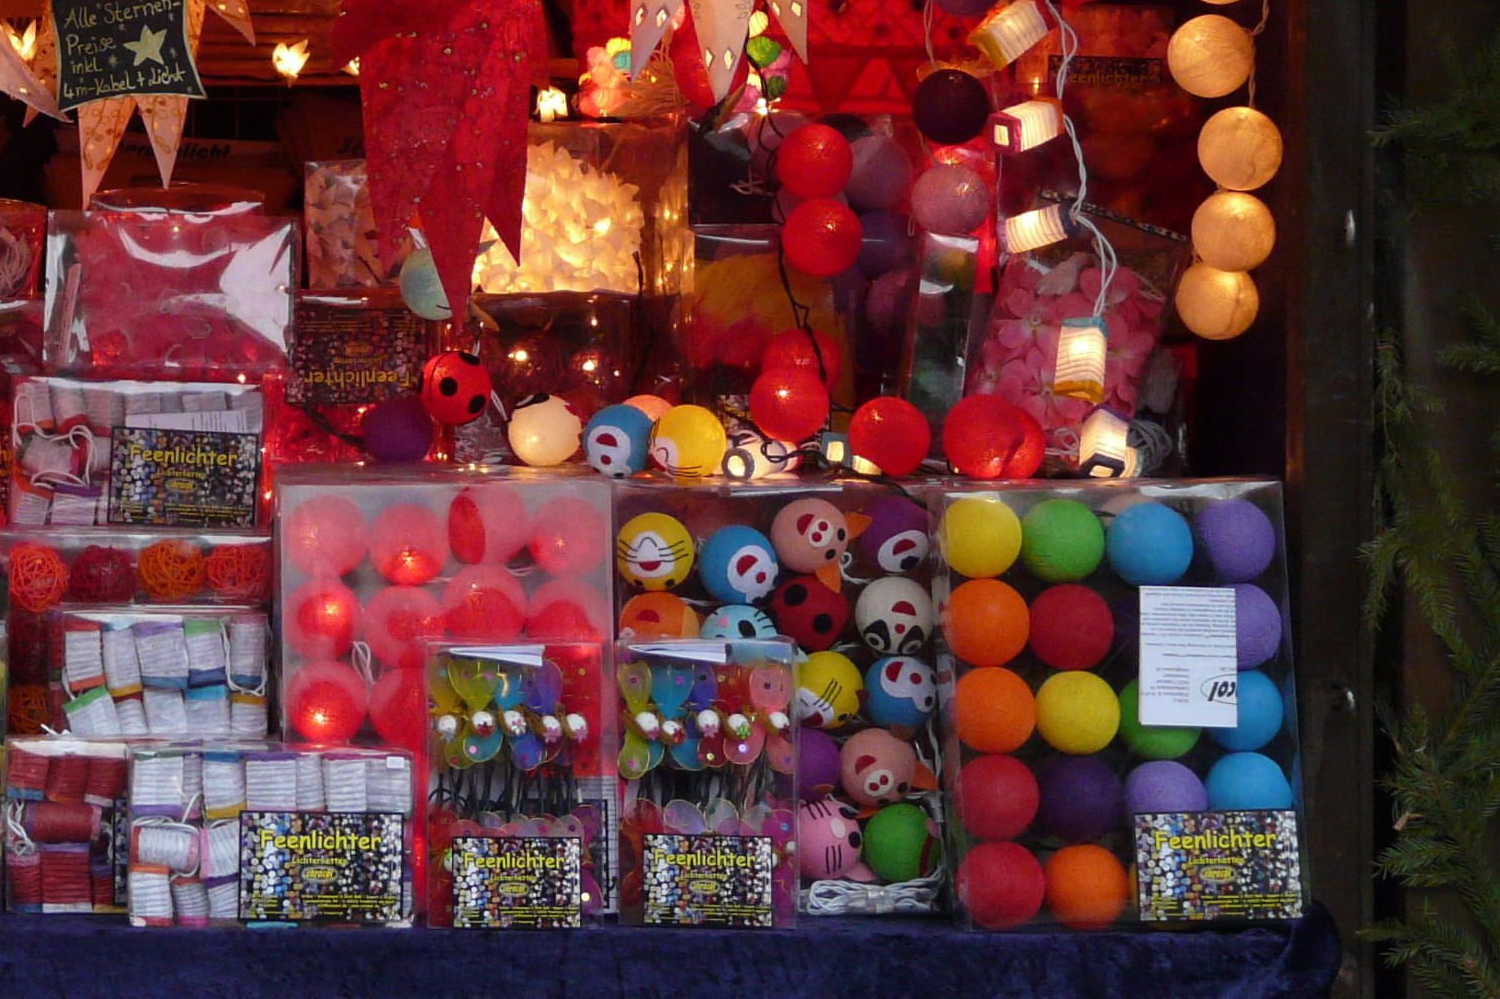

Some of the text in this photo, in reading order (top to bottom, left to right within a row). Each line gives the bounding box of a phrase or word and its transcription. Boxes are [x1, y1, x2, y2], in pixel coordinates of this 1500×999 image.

[64, 7, 97, 29] Alle
[66, 35, 116, 56] Preise
[72, 57, 102, 74] inkl
[149, 64, 187, 85] Licht
[303, 370, 412, 389] Feenlichter
[130, 444, 240, 466] Feenlichter
[260, 830, 382, 851] Feenlichter
[1154, 828, 1278, 850] Feenlichter
[463, 852, 566, 870] Feenlichter
[653, 849, 756, 869] Feenlichter
